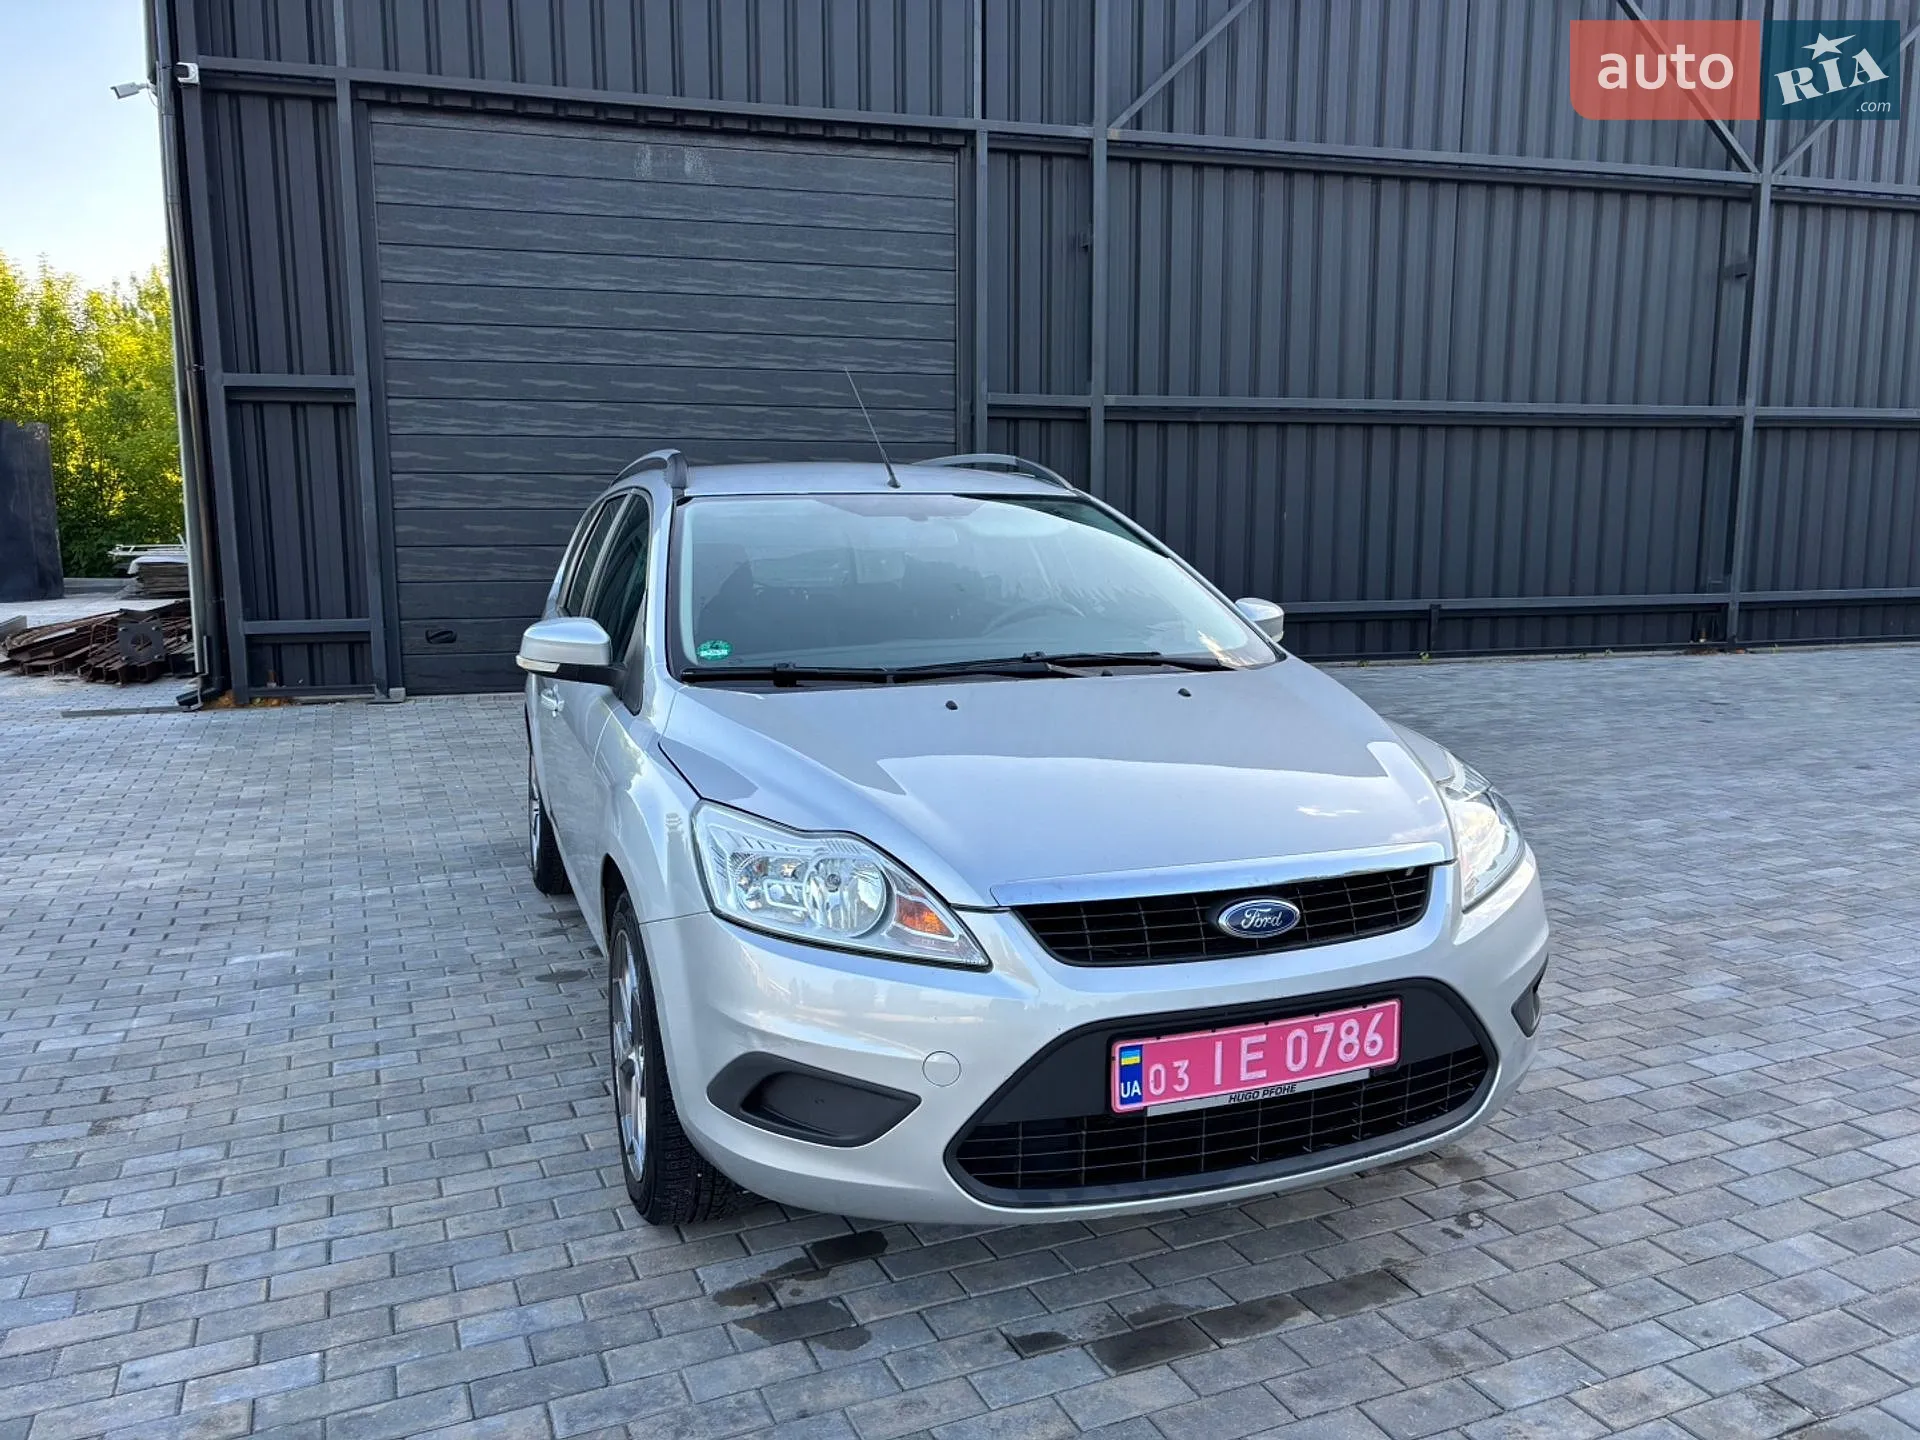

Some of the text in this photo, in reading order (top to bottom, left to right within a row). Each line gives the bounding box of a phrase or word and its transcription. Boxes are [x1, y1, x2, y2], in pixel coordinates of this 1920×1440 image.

[1241, 908, 1284, 929] Ford
[1149, 1060, 1190, 1096] 03
[1285, 1012, 1384, 1072] 0786
[1120, 1080, 1142, 1098] UA
[1228, 1083, 1297, 1103] HUGO PFOHE
